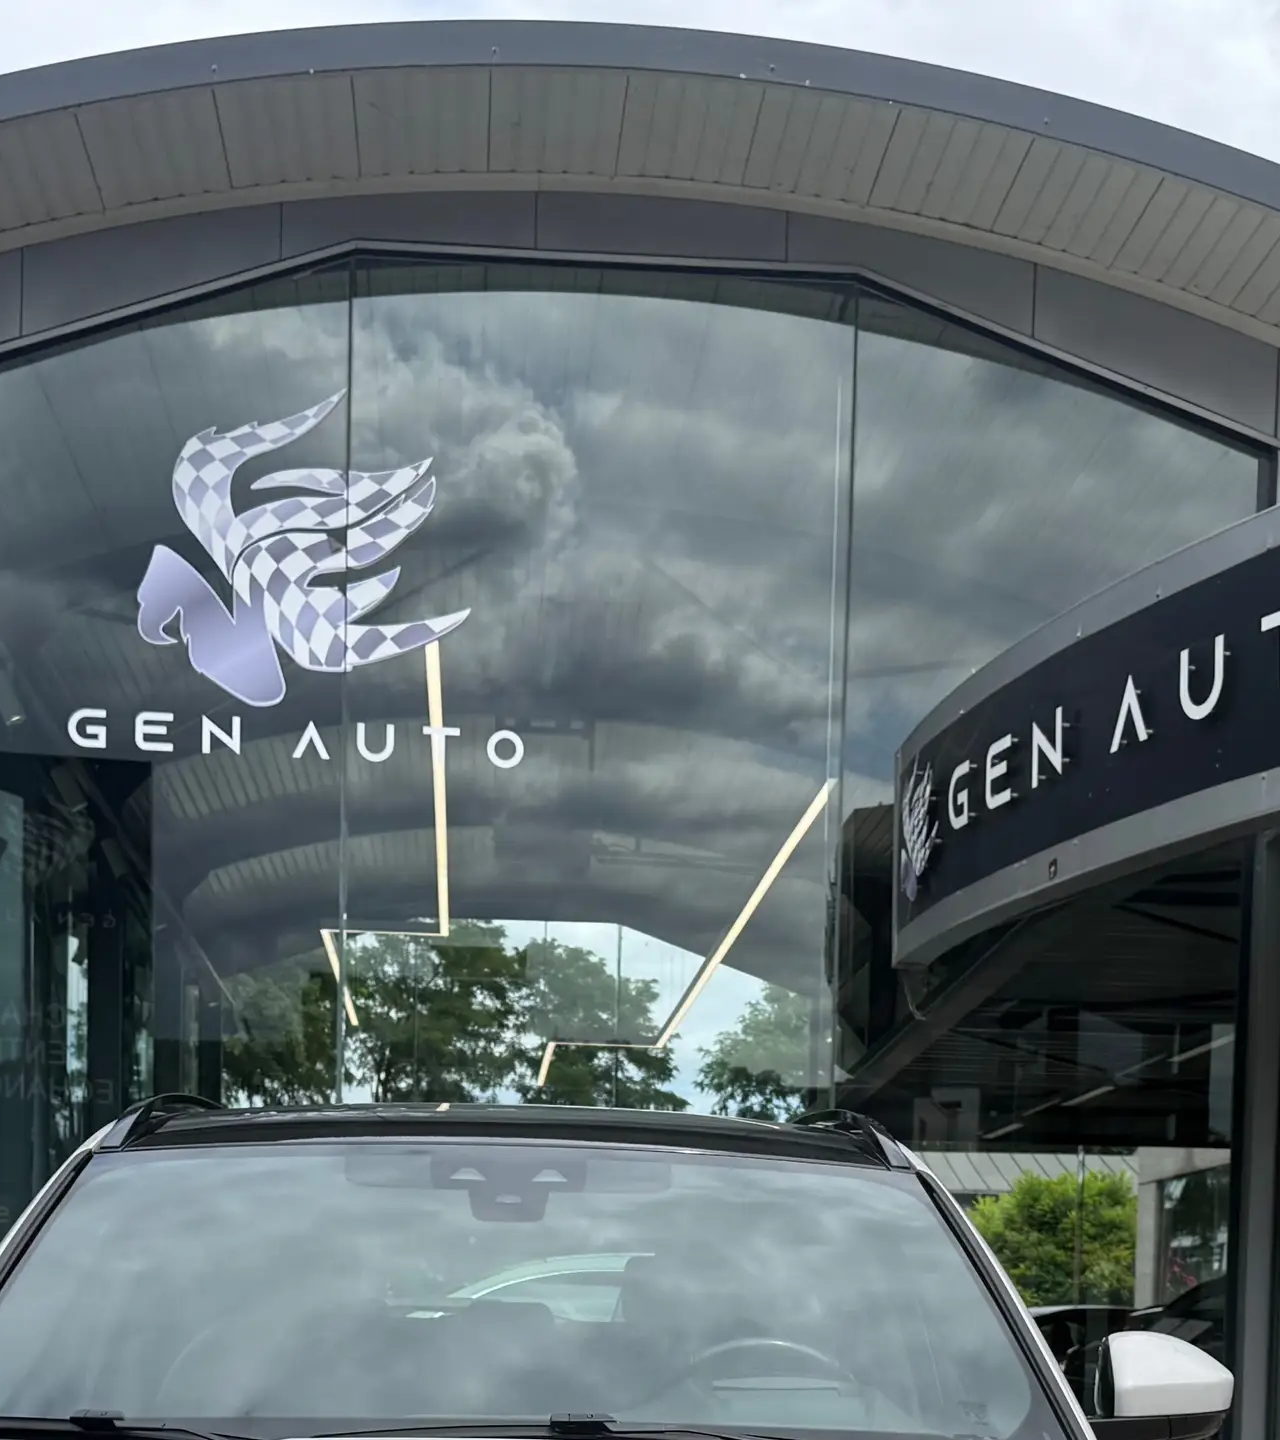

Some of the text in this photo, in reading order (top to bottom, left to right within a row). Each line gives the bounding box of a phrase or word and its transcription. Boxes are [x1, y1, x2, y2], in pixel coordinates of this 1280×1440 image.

[67, 708, 525, 769] GEN AUTO
[948, 706, 1062, 830] GEN
